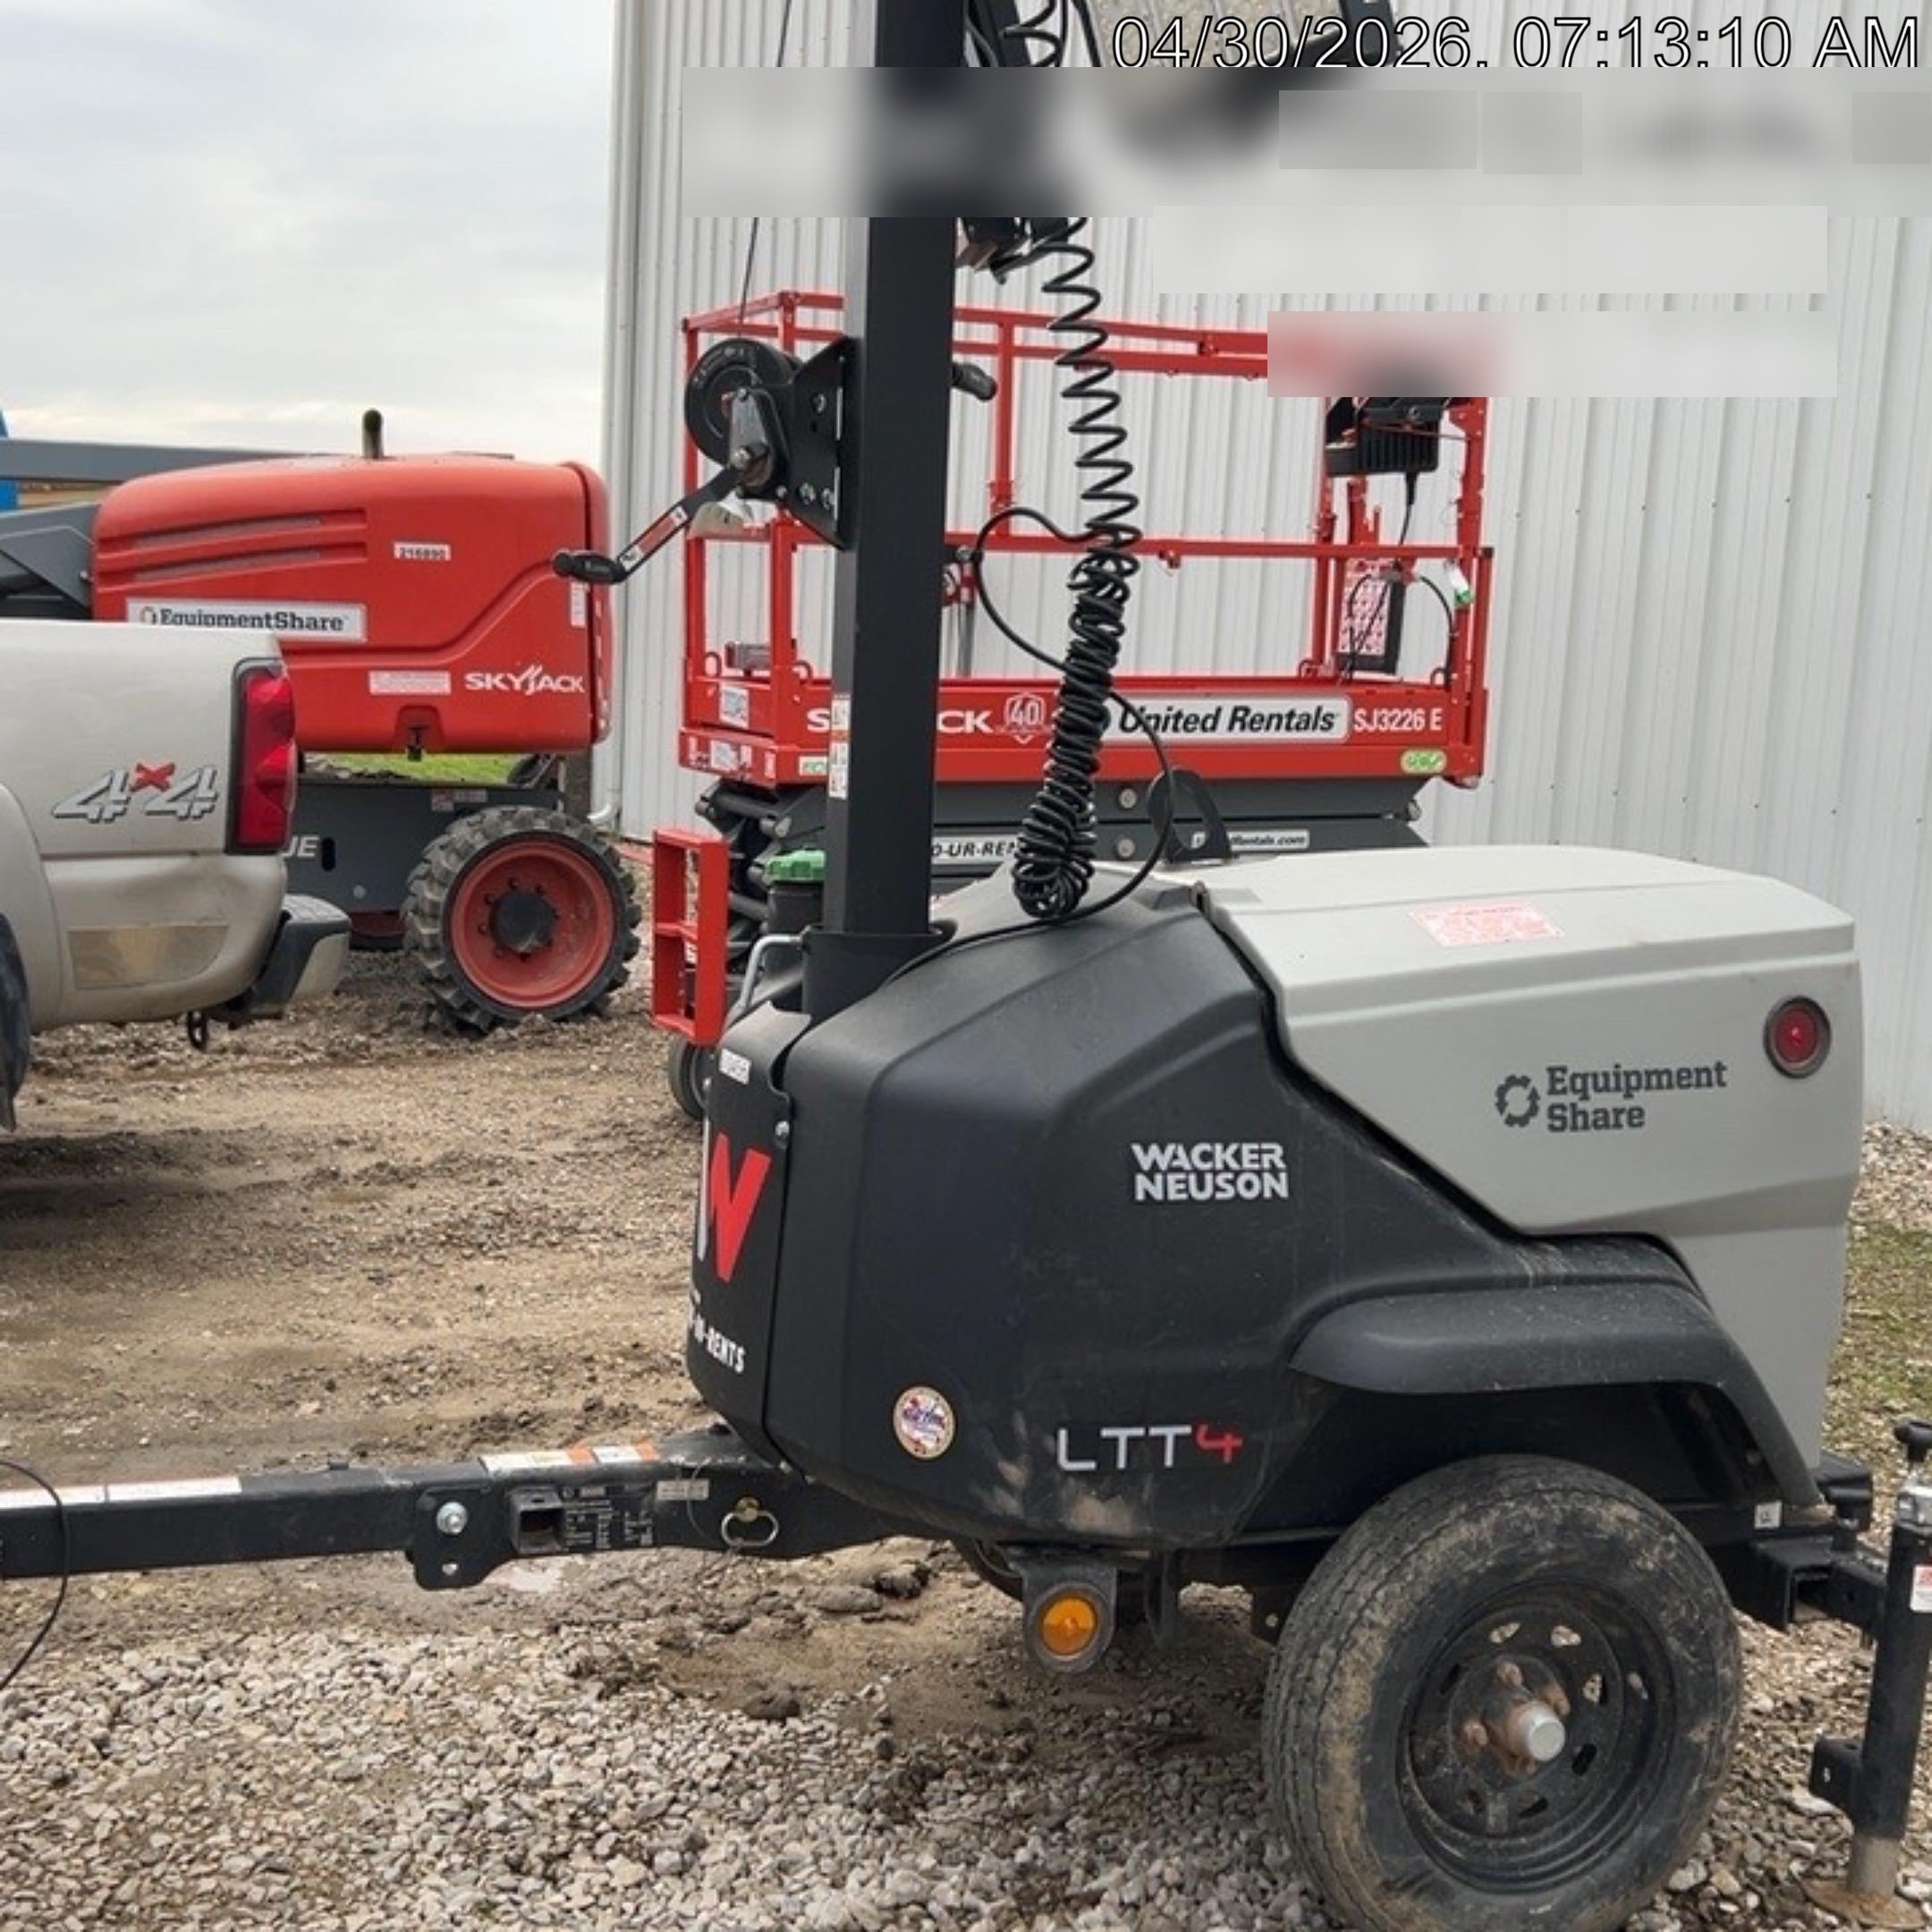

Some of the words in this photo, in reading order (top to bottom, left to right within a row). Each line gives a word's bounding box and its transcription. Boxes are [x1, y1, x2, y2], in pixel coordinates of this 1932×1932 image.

[160, 608, 344, 631] EquipmentShare
[464, 665, 586, 696] SKYJACK
[1118, 705, 1222, 733] United
[1228, 705, 1335, 732] Rentals
[1353, 708, 1426, 732] SJ3226
[1429, 708, 1443, 731] E
[1546, 1061, 1728, 1101] Equipment
[1546, 1102, 1646, 1133] Share
[1130, 1141, 1287, 1172] WACKER
[1134, 1172, 1289, 1201] NEUSON
[1056, 1424, 1244, 1471] LTT4
